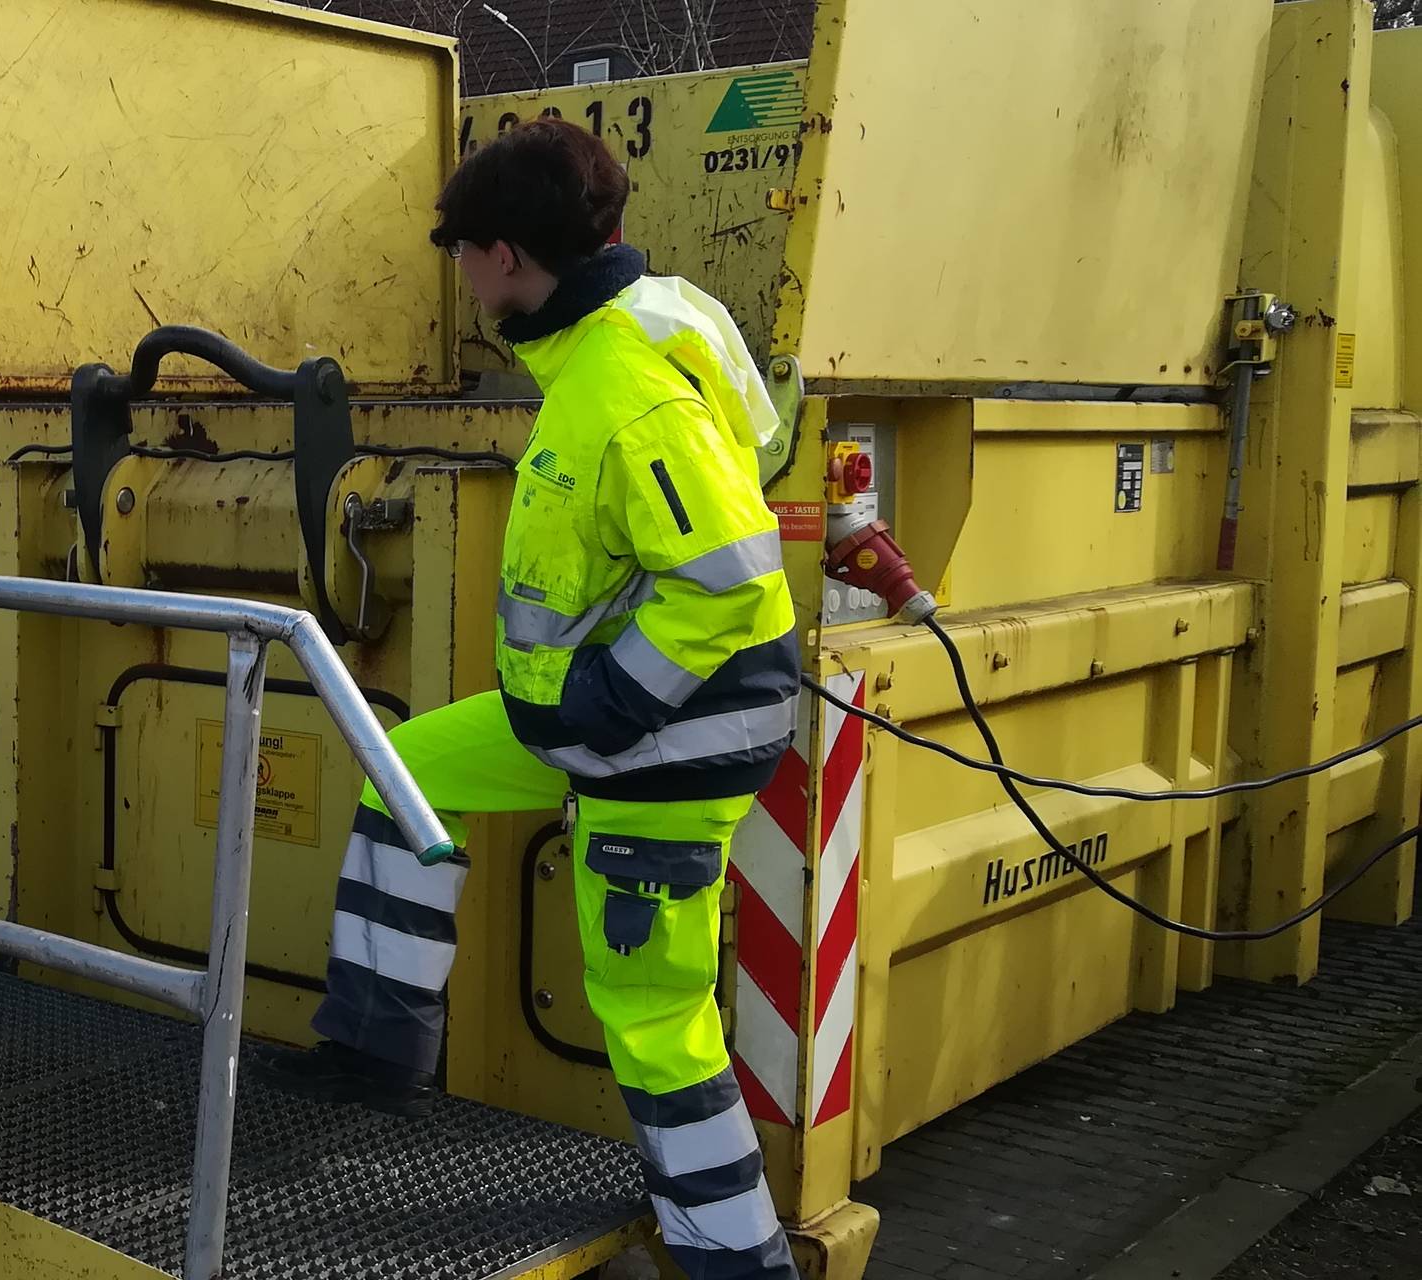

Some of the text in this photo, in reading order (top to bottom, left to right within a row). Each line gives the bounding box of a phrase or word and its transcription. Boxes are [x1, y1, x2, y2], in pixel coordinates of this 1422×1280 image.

[727, 131, 790, 144] ENTSORGUNG
[704, 141, 803, 173] 0231/91
[558, 472, 576, 486] EDG
[794, 506, 820, 514] TASTER
[256, 786, 296, 800] gsklappe
[983, 833, 1108, 905] Husmann
